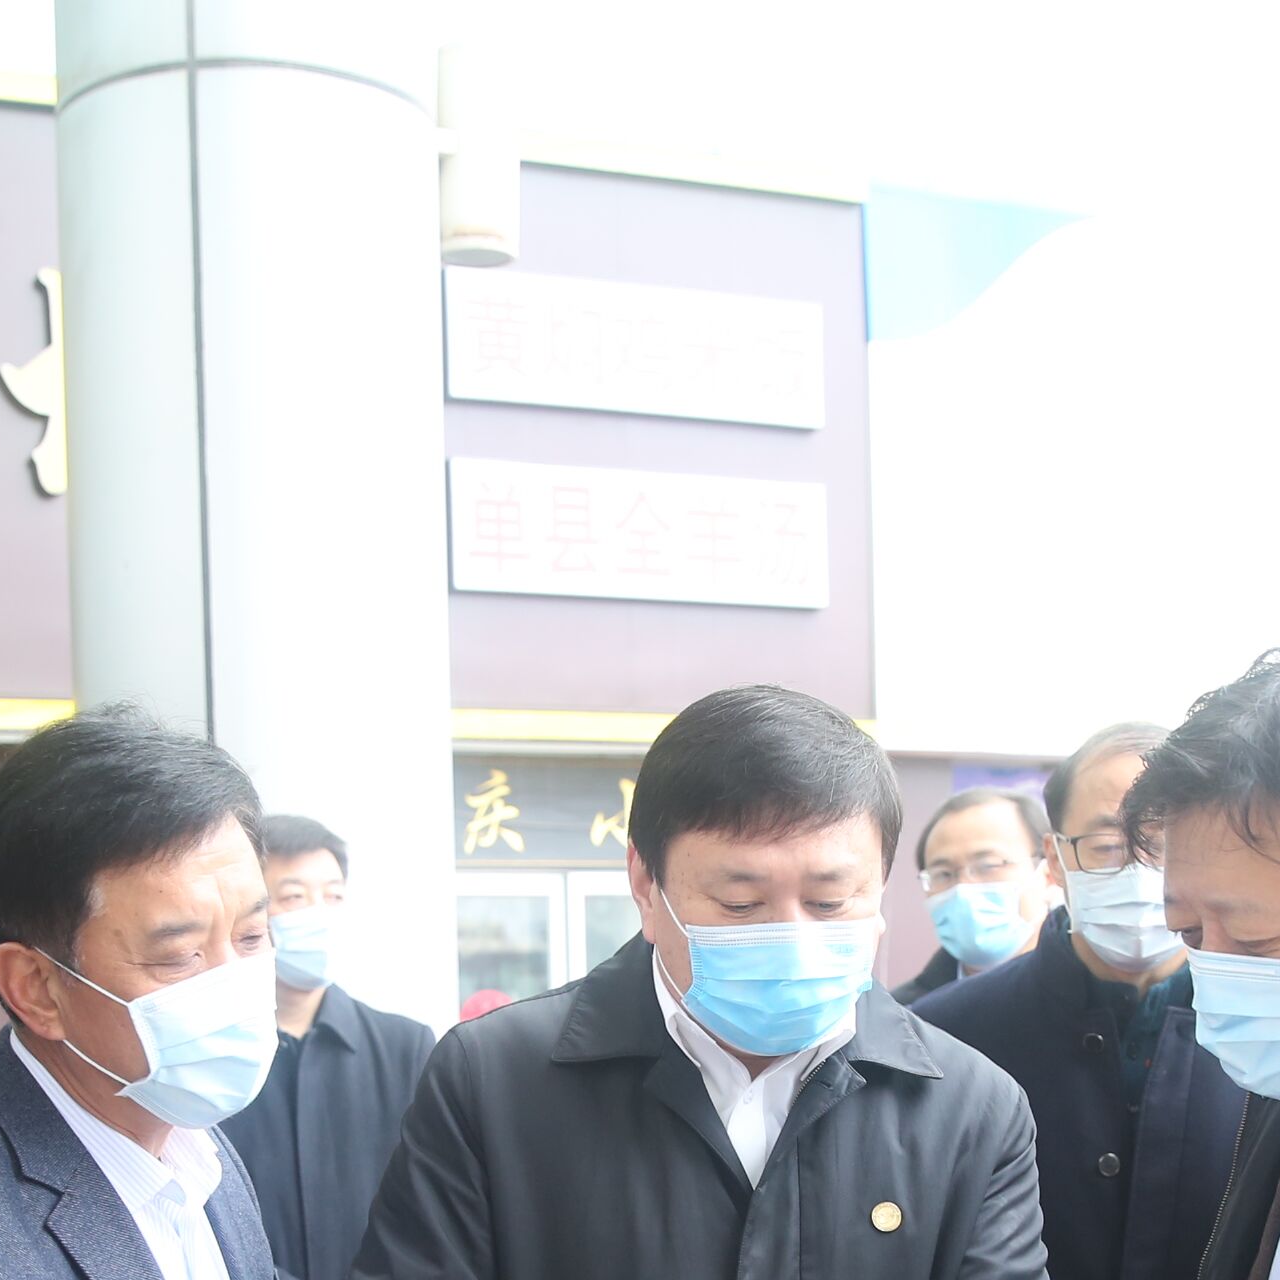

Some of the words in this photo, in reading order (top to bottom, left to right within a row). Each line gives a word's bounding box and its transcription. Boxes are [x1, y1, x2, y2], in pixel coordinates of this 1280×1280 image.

[468, 479, 810, 585] 单县全羊汤
